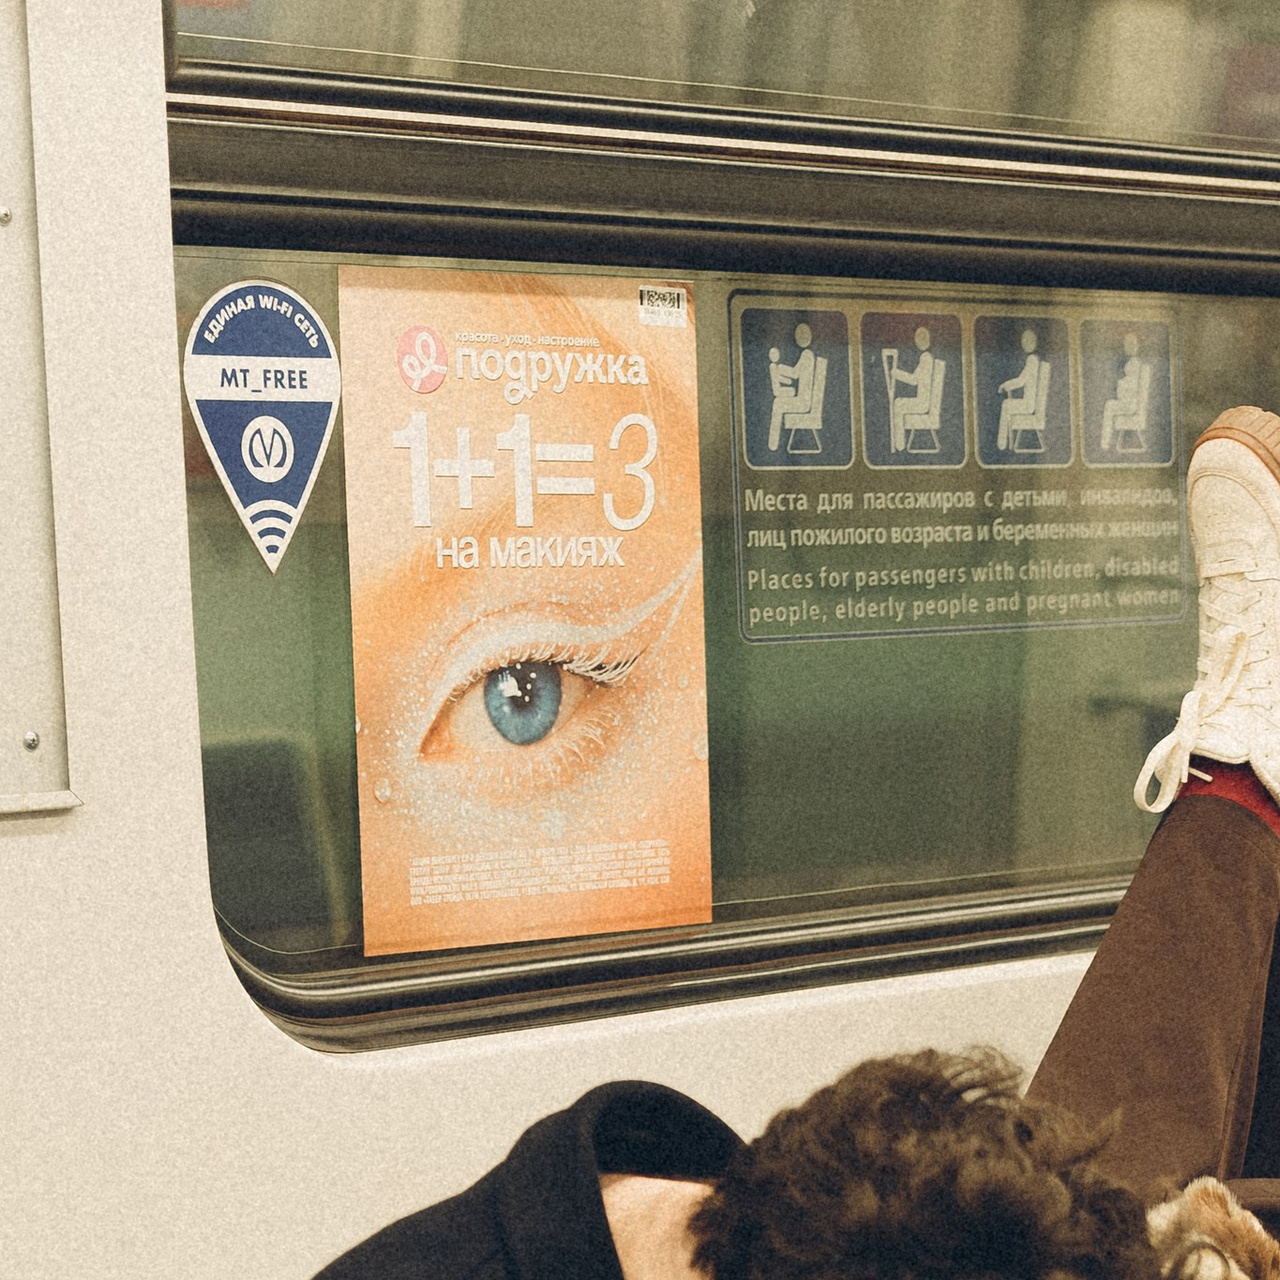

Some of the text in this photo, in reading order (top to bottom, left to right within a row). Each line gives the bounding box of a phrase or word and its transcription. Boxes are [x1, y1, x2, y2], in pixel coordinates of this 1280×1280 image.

[203, 294, 319, 348] ЕДИНАЯ WI-FI СЕТЬ
[455, 332, 600, 347] красота уход настроение
[220, 367, 308, 392] MT_FREE
[455, 346, 650, 405] подружка
[744, 488, 808, 512] Места
[816, 492, 853, 514] для
[863, 490, 976, 514] пассажиров
[983, 489, 994, 508] с
[746, 518, 1179, 550] лиц пожилого возраста и беременных женщин
[435, 536, 626, 568] на макияж
[747, 554, 1180, 592] Places for passengers with children, disabled
[749, 588, 1180, 628] people, elderly people and pregnant women
